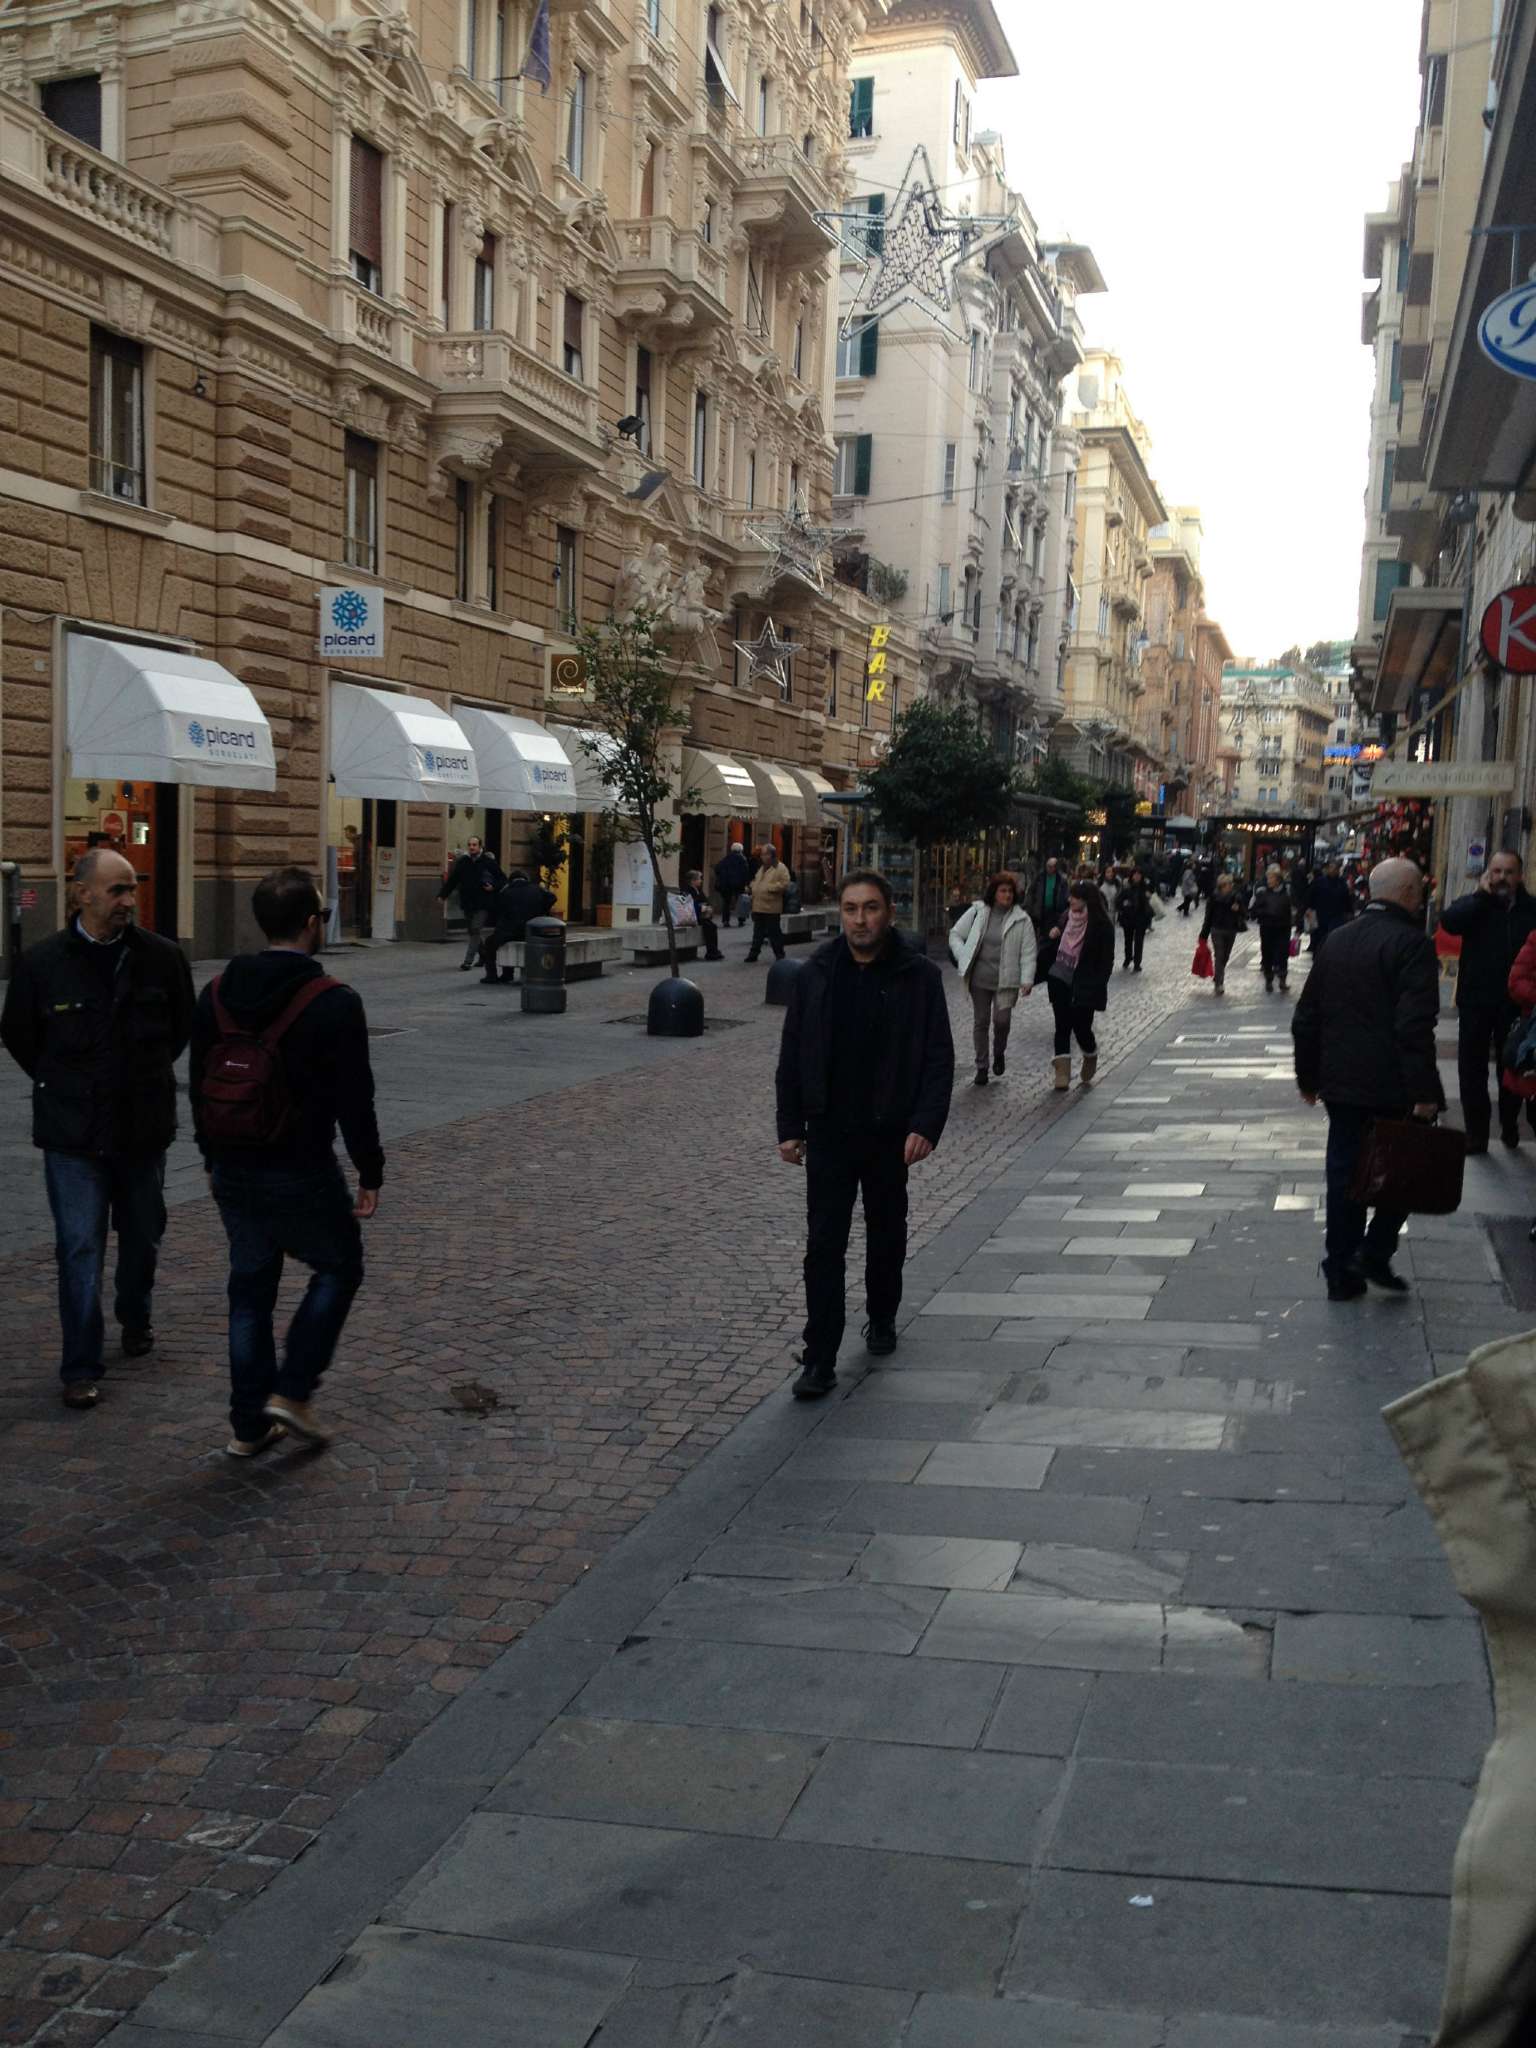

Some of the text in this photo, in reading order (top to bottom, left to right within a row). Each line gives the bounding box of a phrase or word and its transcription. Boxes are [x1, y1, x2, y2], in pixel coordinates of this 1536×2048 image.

[324, 633, 376, 648] picard
[866, 624, 891, 702] BAR
[206, 726, 256, 749] picard
[436, 755, 468, 771] picard
[542, 768, 567, 783] picard
